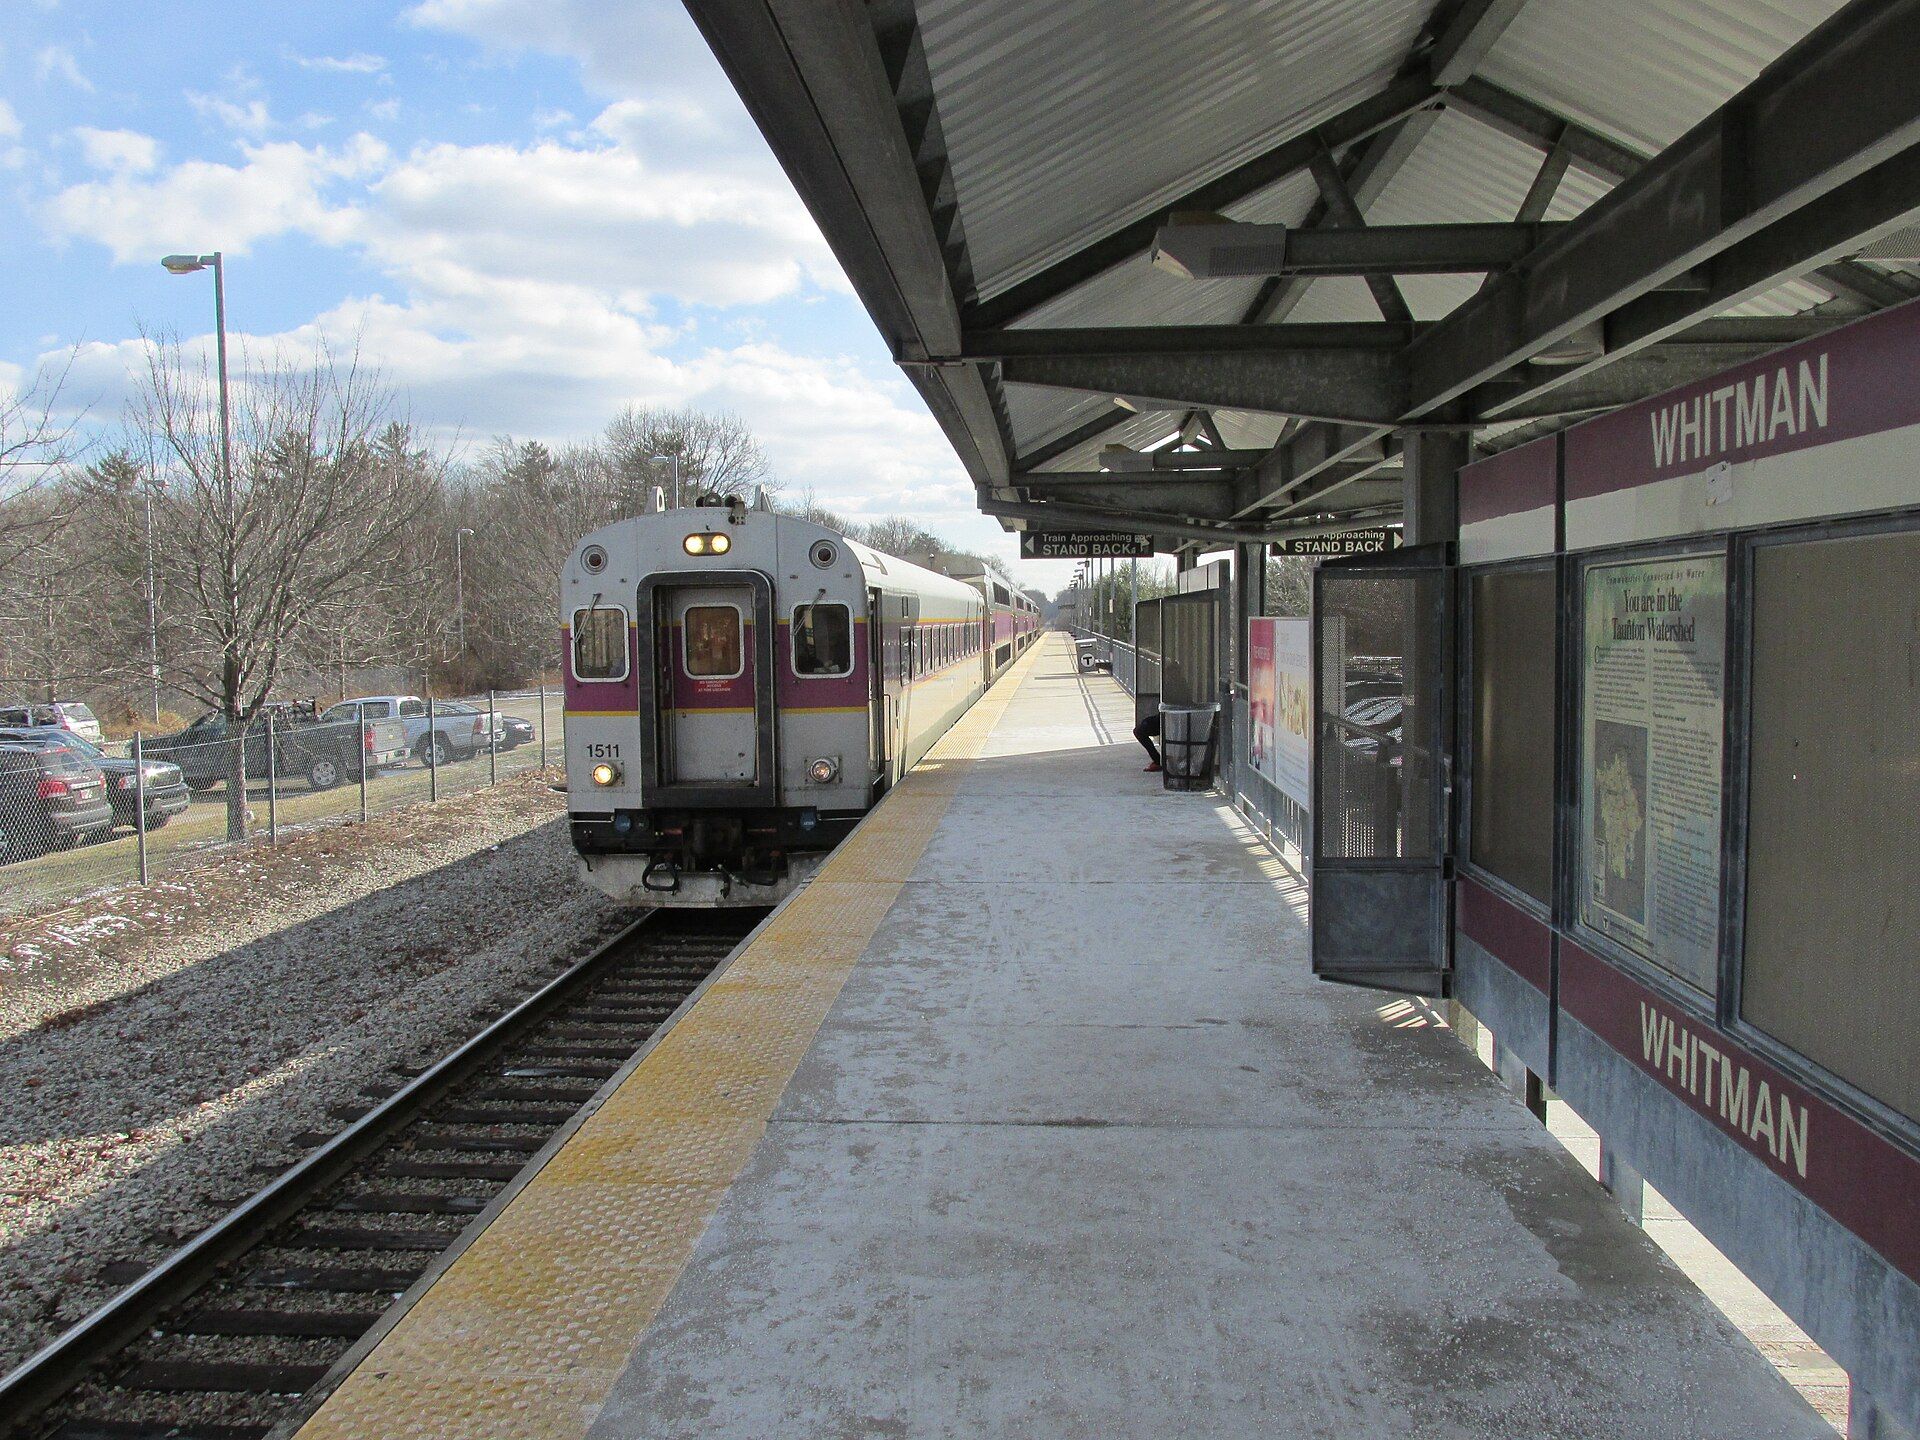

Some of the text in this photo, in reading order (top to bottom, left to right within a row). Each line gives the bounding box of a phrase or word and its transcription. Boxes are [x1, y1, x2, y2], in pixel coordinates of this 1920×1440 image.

[1650, 352, 1829, 469] WHITMAN
[1042, 533, 1132, 543] Train Approaching
[1294, 540, 1384, 553] STAND BACK
[1042, 544, 1088, 556] STAND
[1092, 543, 1131, 555] BACK
[1624, 587, 1682, 612] You are in the
[1647, 617, 1696, 642] Watershed
[587, 744, 619, 757] 1511
[1640, 1001, 1808, 1179] WHITMAN
